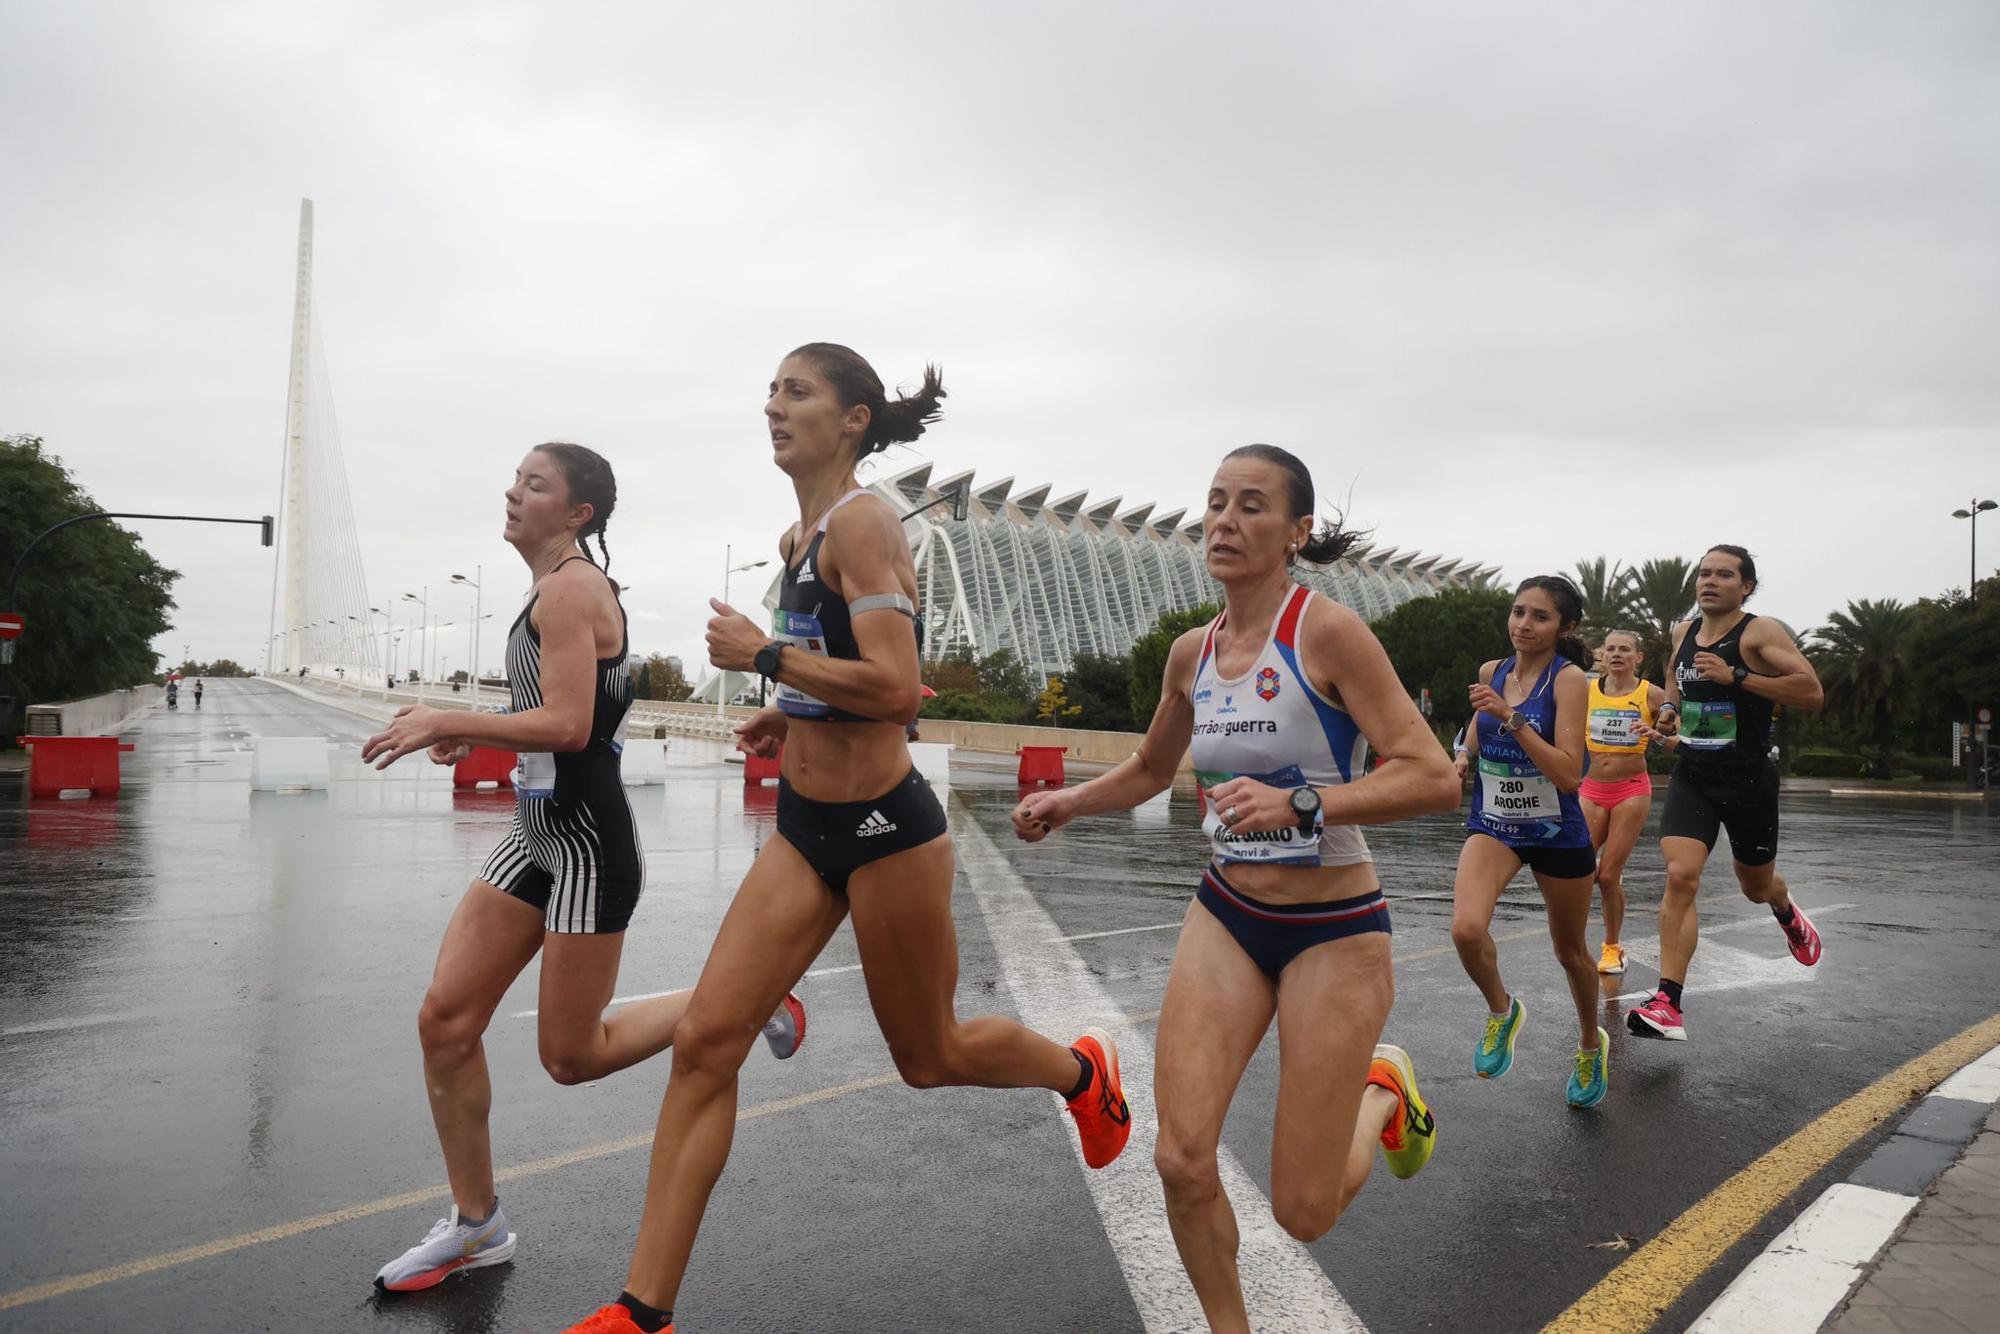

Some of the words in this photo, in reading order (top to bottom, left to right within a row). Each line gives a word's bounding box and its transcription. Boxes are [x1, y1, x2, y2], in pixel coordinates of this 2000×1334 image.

[1606, 719, 1623, 727] 237
[1481, 743, 1527, 760] VIVIAN
[1499, 781, 1524, 793] 280
[1494, 795, 1540, 809] AROCHE
[856, 823, 897, 837] adidas
